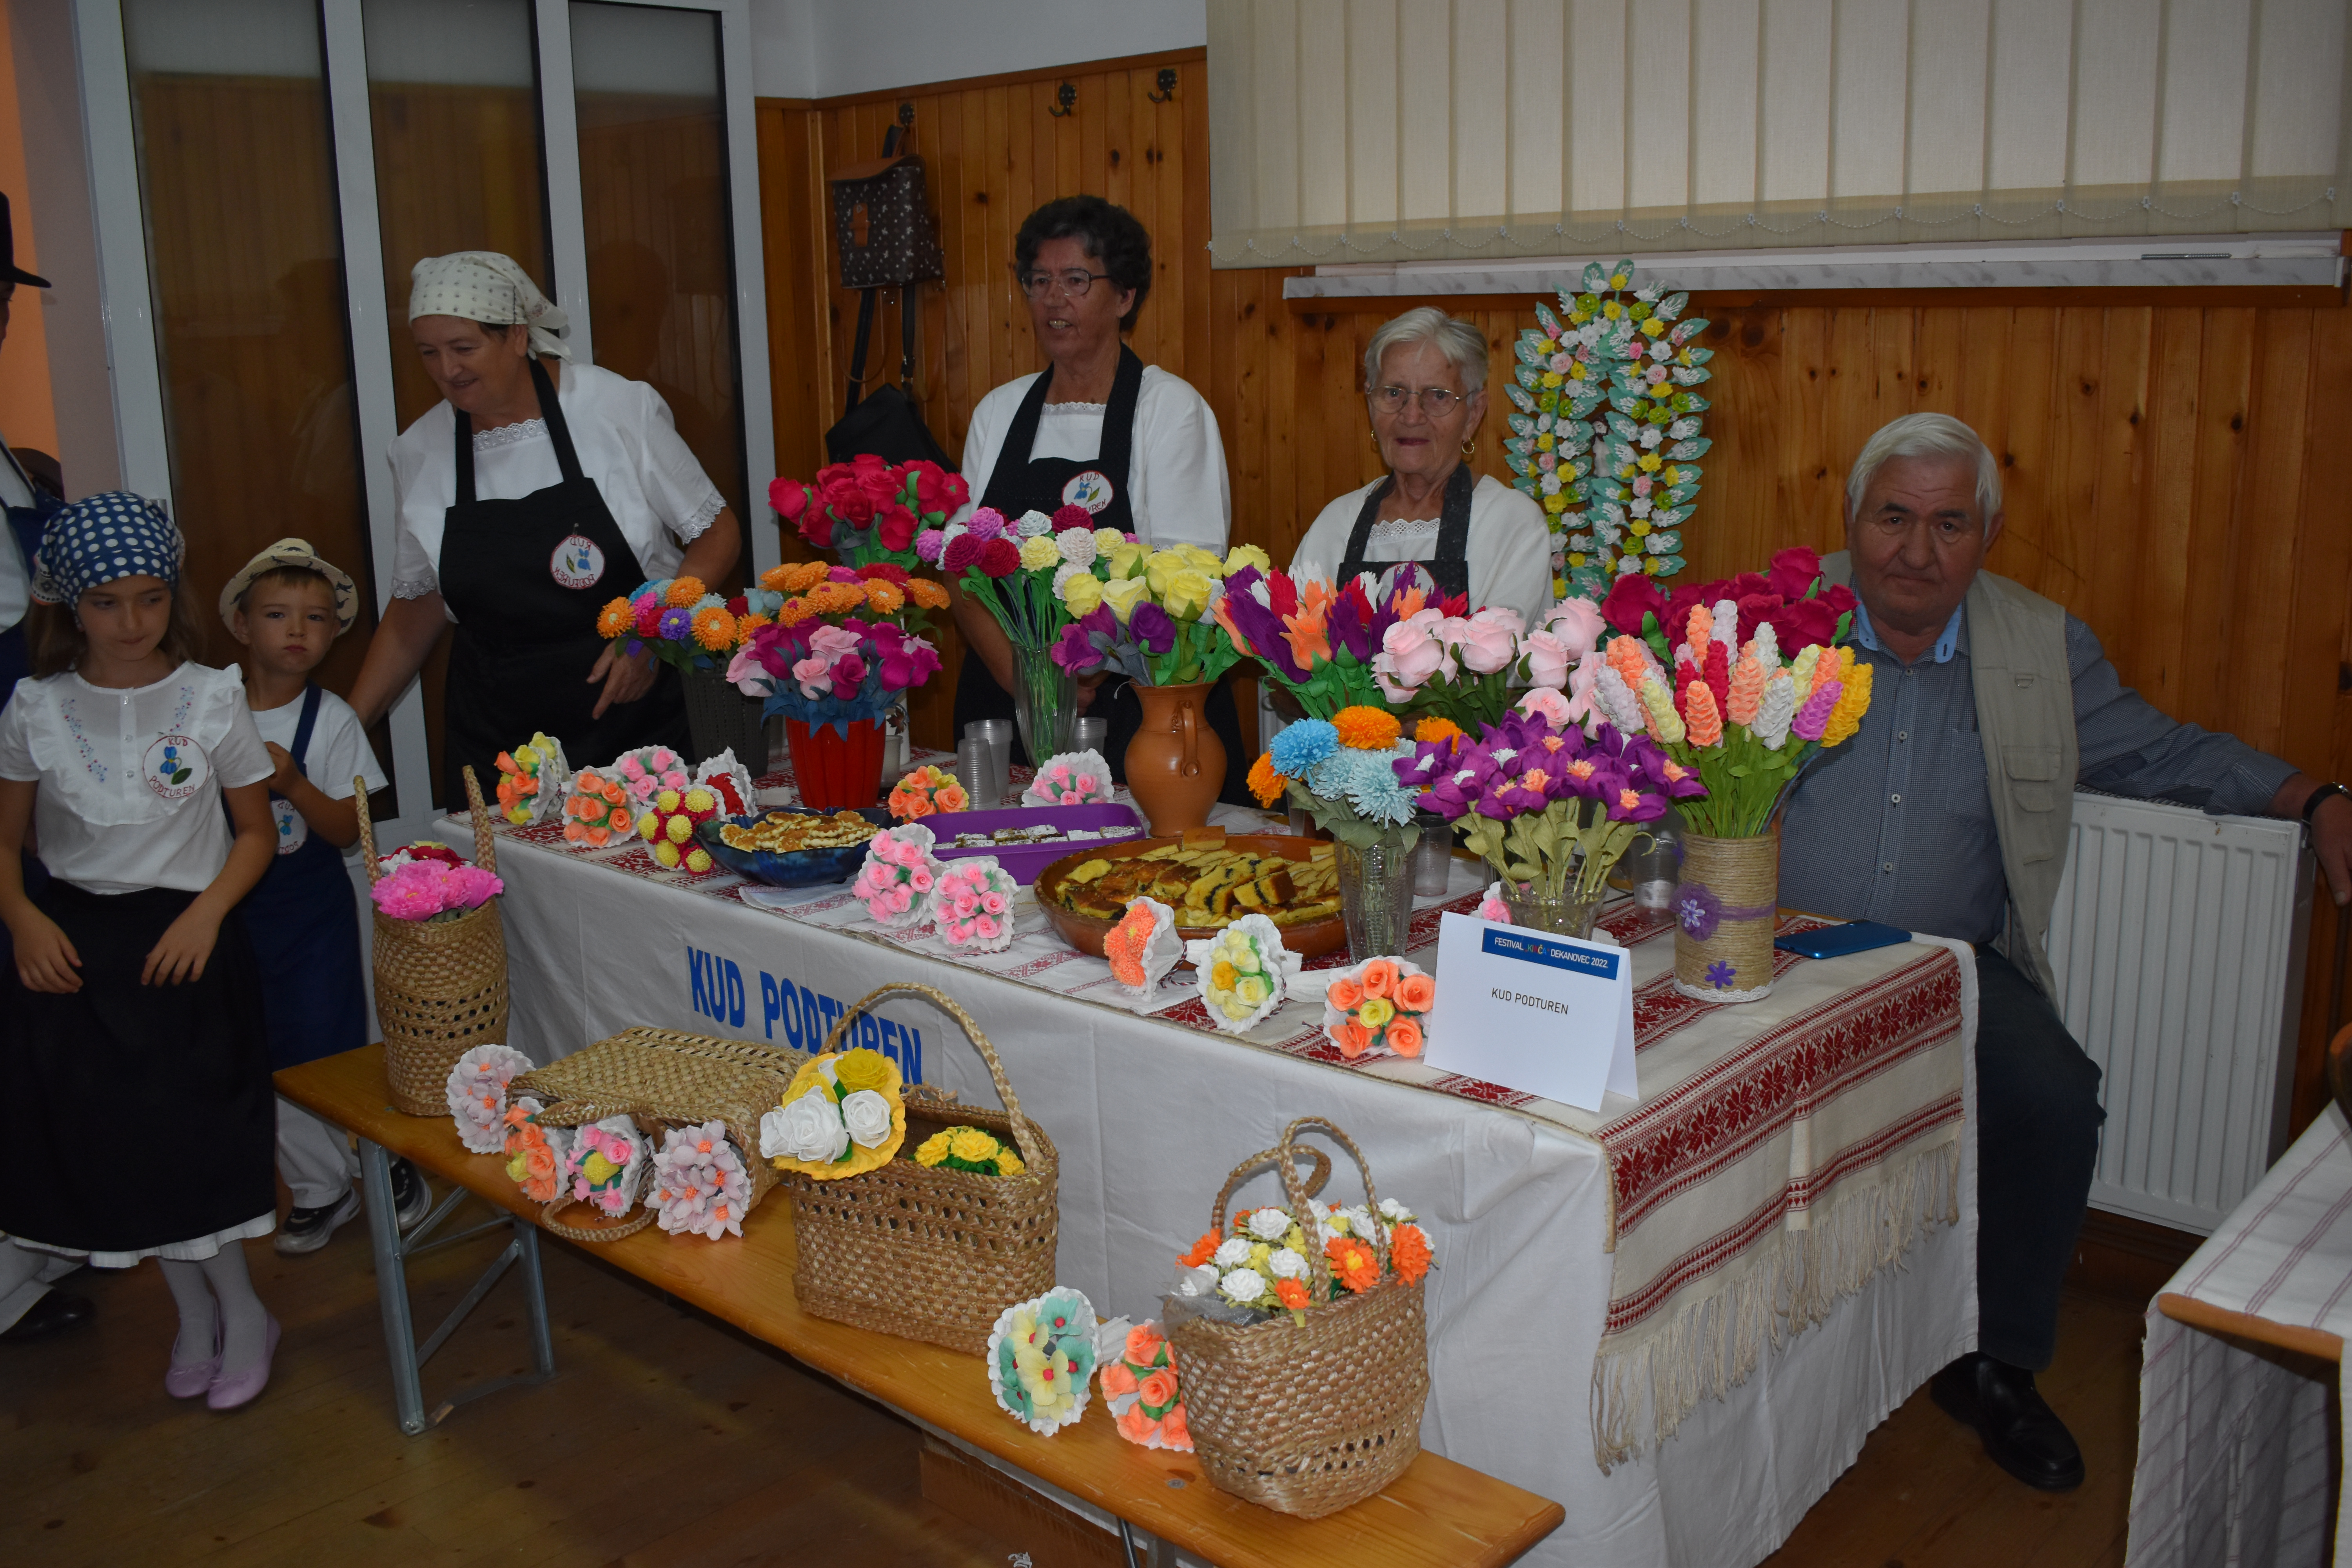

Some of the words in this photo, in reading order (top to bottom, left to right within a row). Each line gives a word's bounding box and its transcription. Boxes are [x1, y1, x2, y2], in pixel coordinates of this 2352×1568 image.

[168, 737, 188, 746] KUD
[149, 775, 195, 797] PODTUREN
[1494, 937, 1524, 951] FESTIVAL
[1550, 949, 1590, 964] DEKANOVEC
[687, 946, 745, 1028] KUD
[1492, 987, 1512, 1001] KUD
[1514, 993, 1568, 1015] PODTUREN
